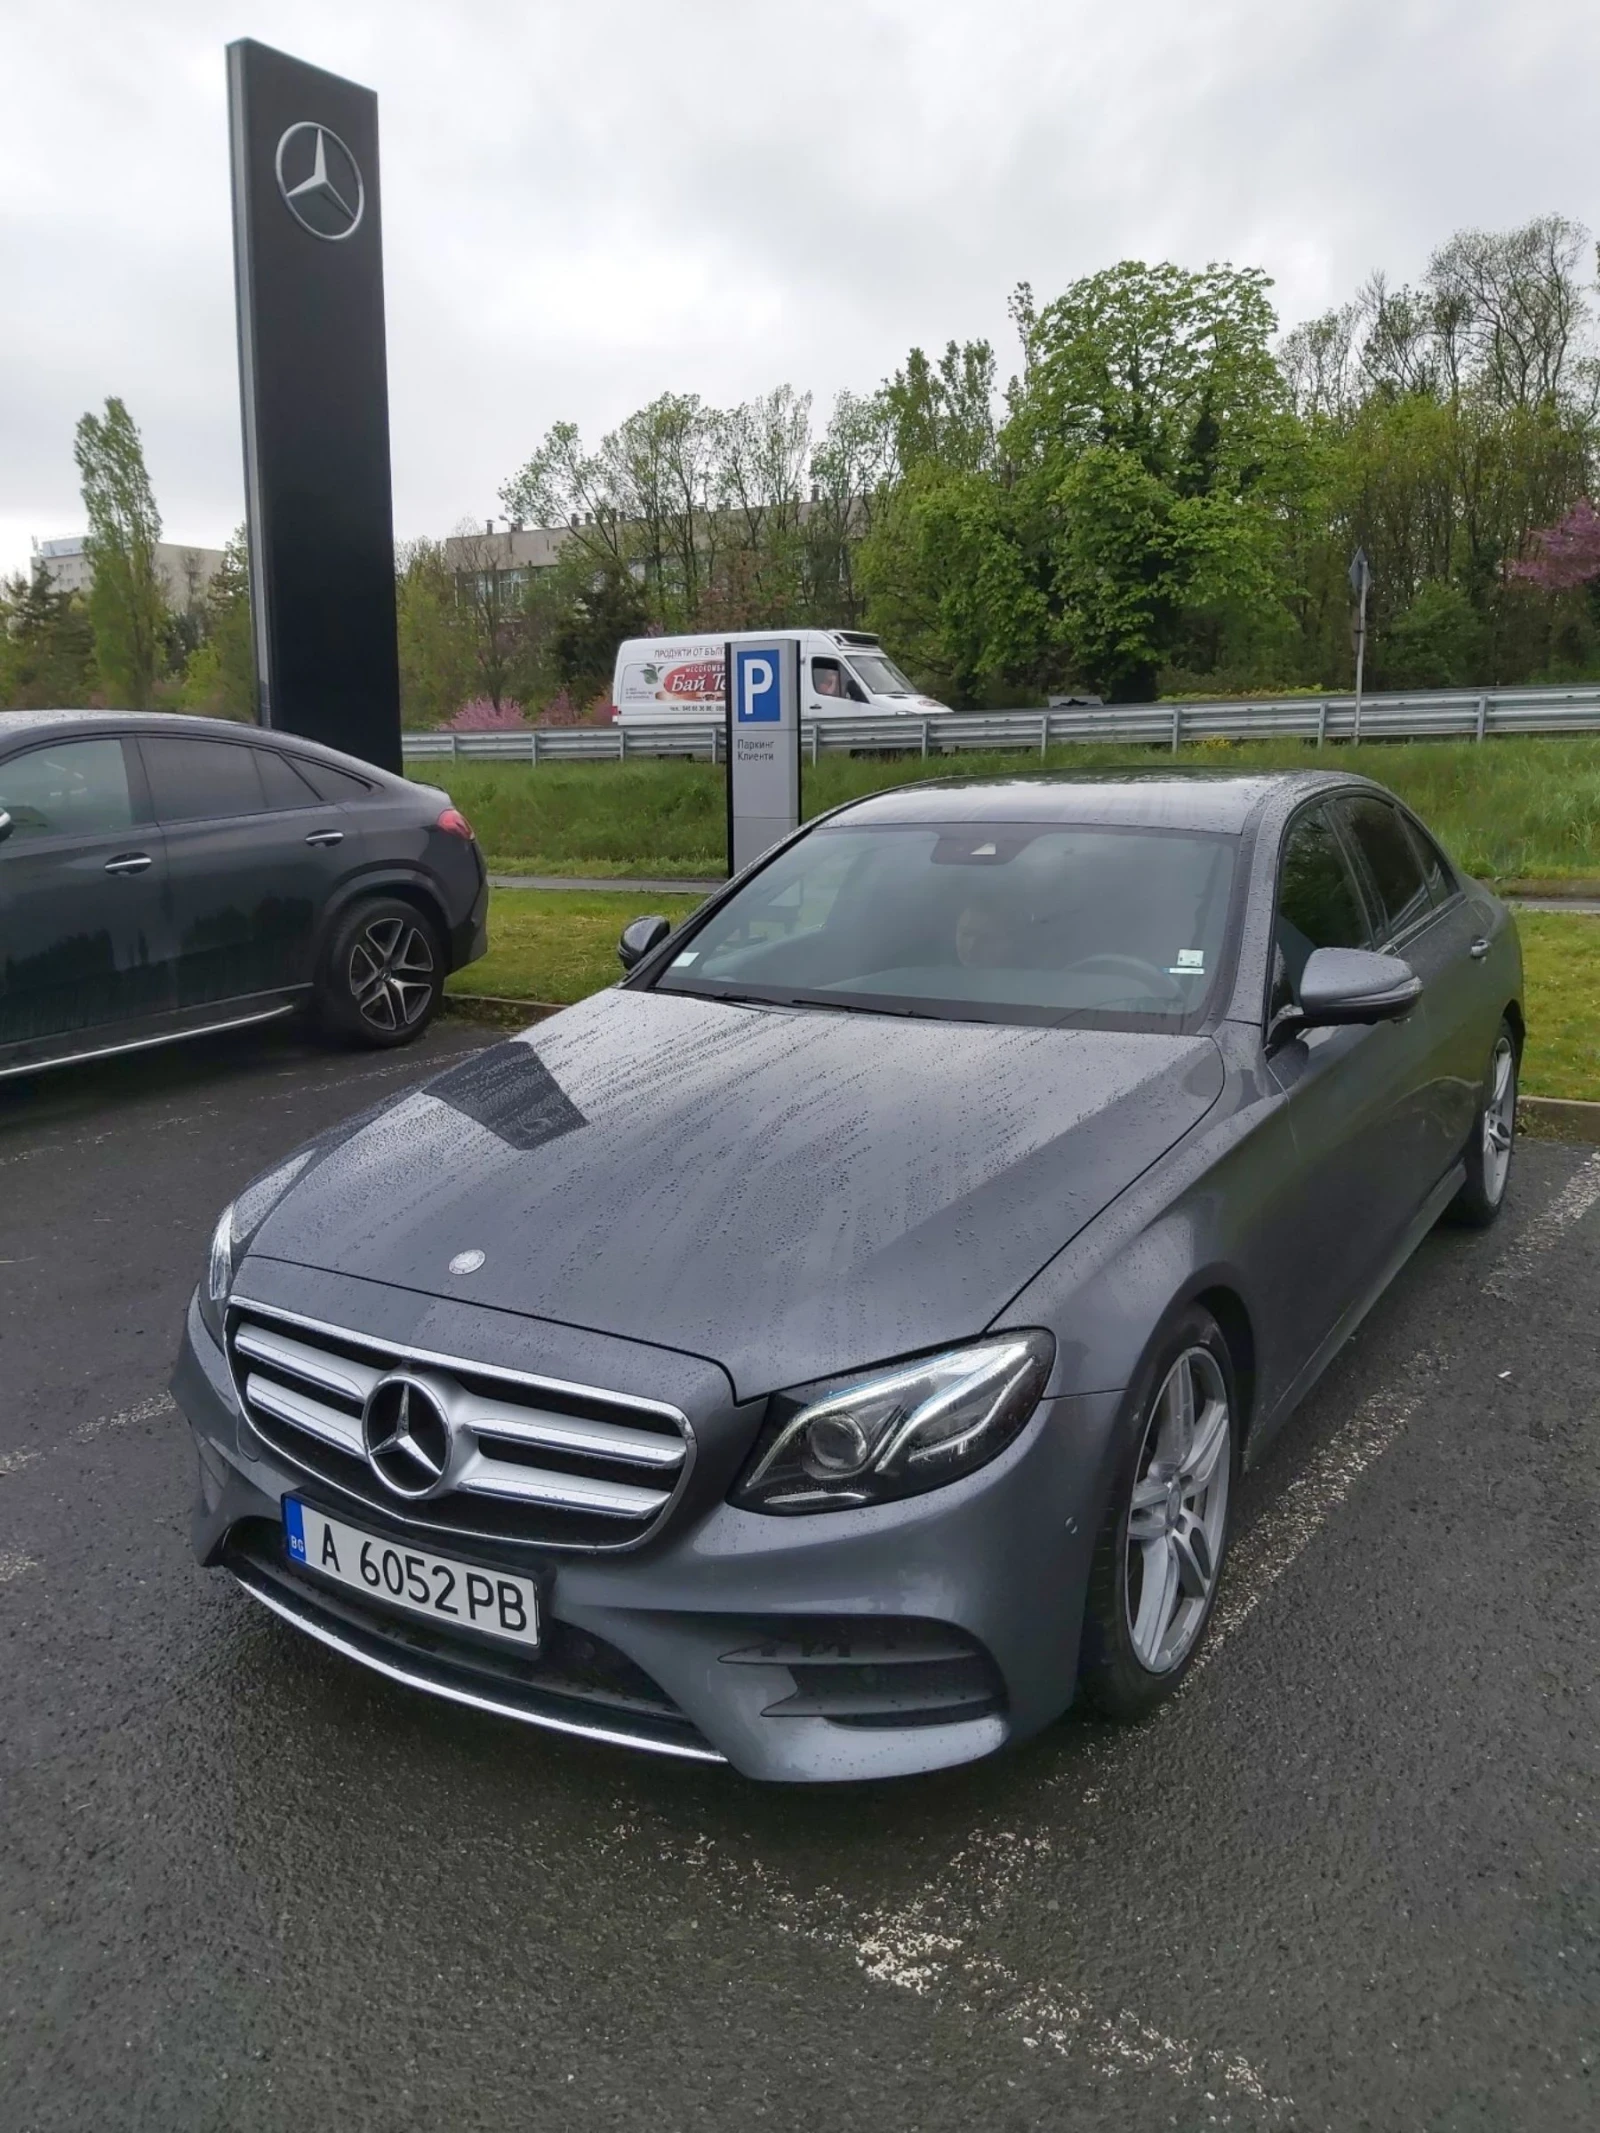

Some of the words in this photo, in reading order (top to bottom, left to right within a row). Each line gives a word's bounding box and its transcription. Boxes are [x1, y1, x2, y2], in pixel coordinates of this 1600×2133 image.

[654, 648, 692, 659] ПРОДУКТИ
[693, 647, 704, 657] ОТ
[704, 646, 726, 656] БЪЛГ
[686, 663, 726, 673] МЕСОКОМБИ
[671, 673, 706, 691] Бай
[713, 673, 726, 691] Те
[744, 659, 773, 714] P
[737, 739, 774, 750] Паркинг
[737, 751, 774, 761] Клиенти
[291, 1535, 305, 1553] BG
[321, 1523, 341, 1572] A
